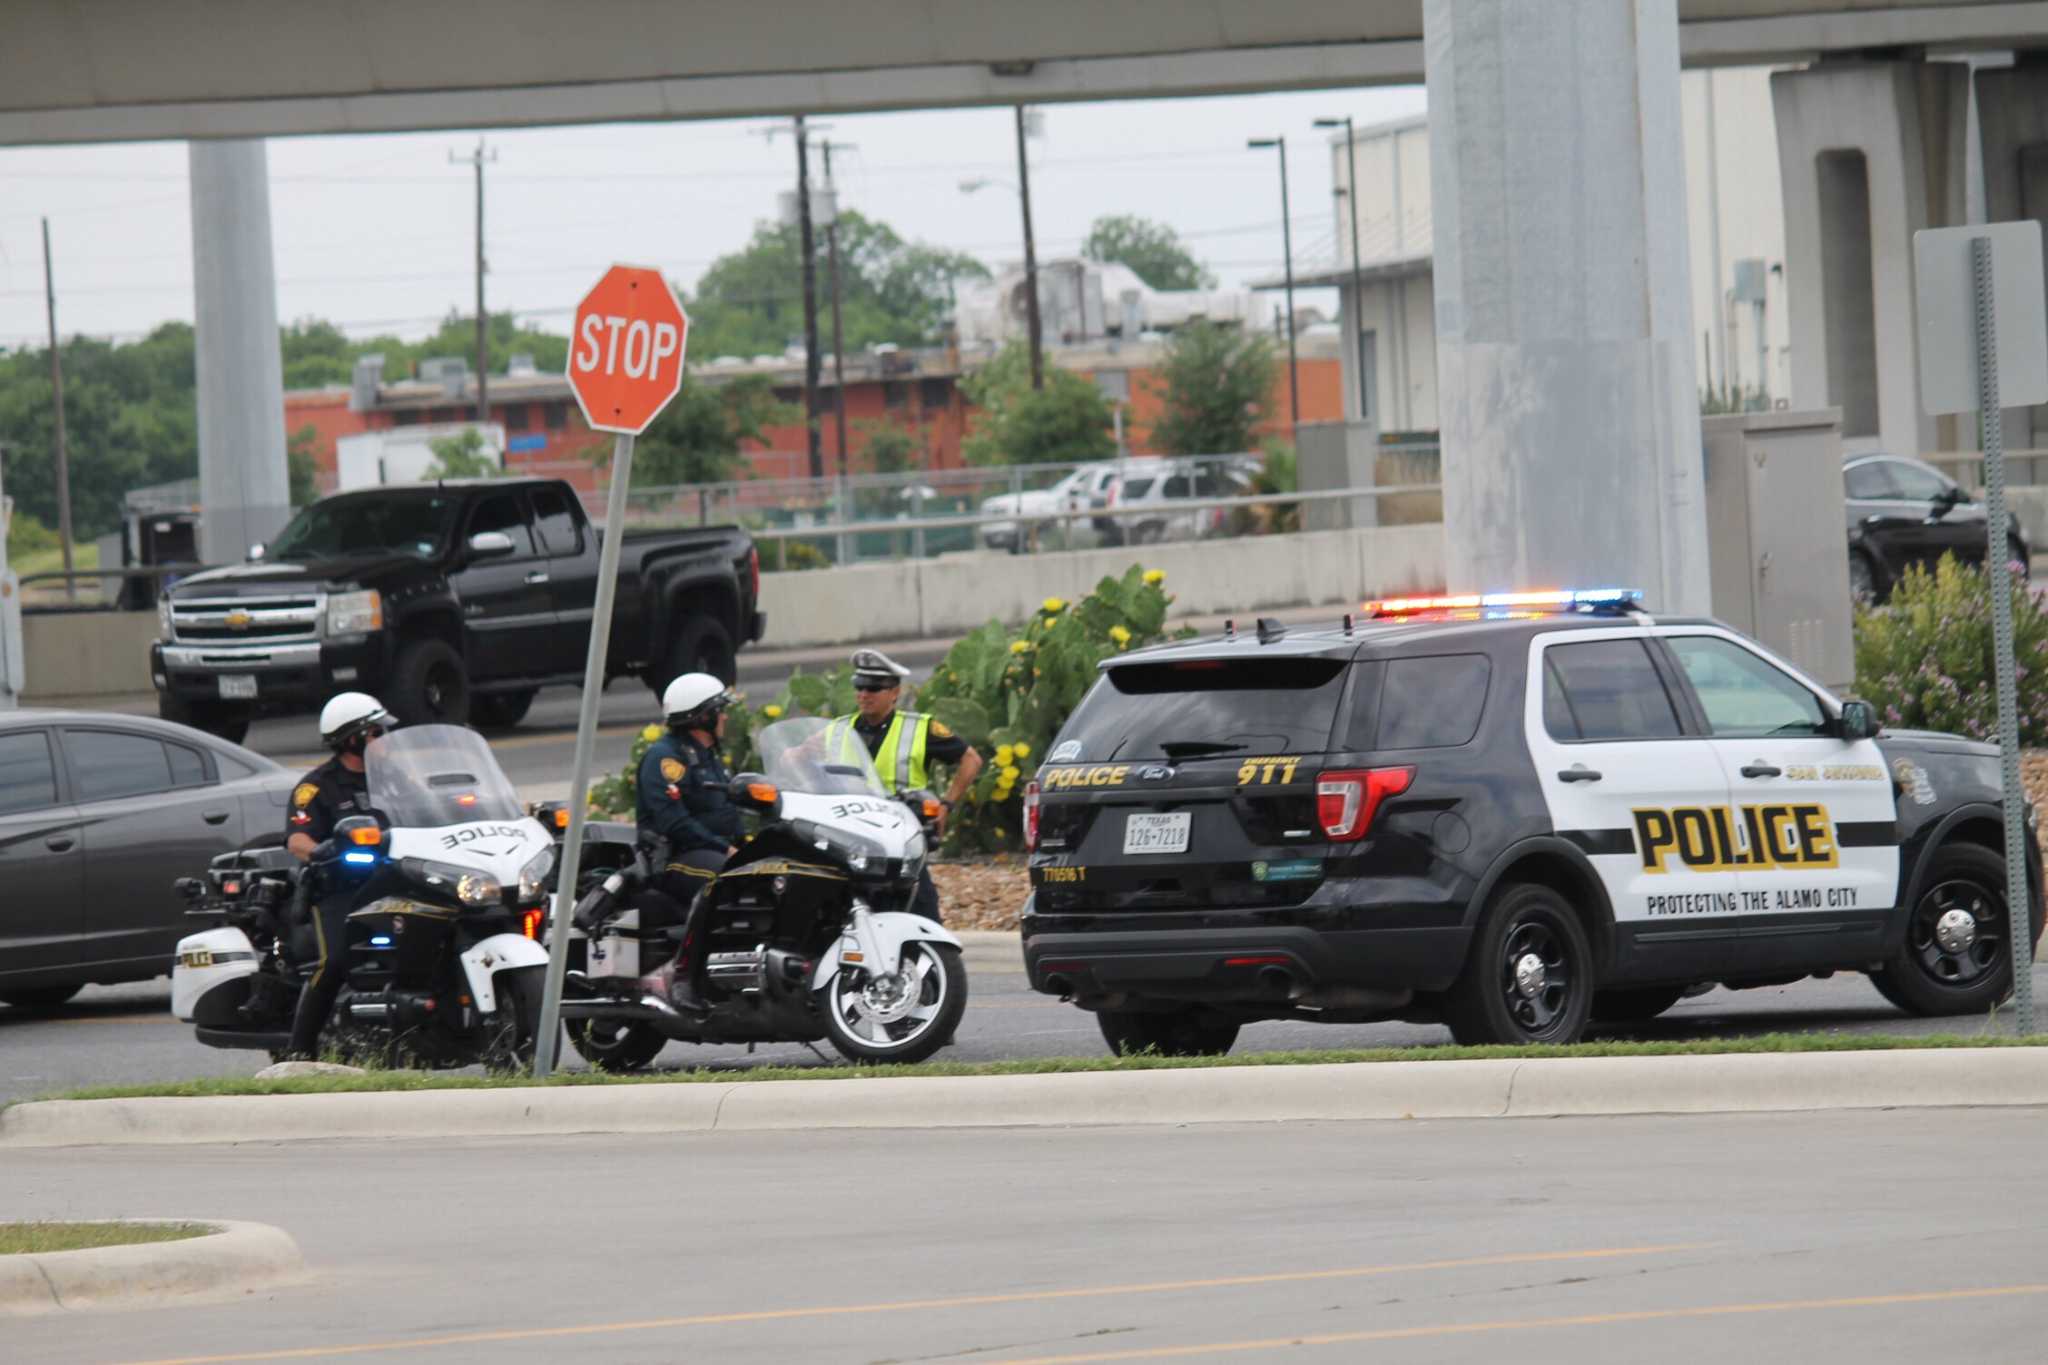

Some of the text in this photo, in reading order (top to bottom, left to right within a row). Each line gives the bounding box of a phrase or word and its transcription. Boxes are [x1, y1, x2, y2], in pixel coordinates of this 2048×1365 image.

[576, 313, 677, 381] STOP
[1044, 766, 1130, 790] POLICE
[1238, 764, 1297, 785] 911
[1632, 804, 1839, 874] POLICE
[1647, 887, 1858, 915] PROTECTING THE ALAMO CITY
